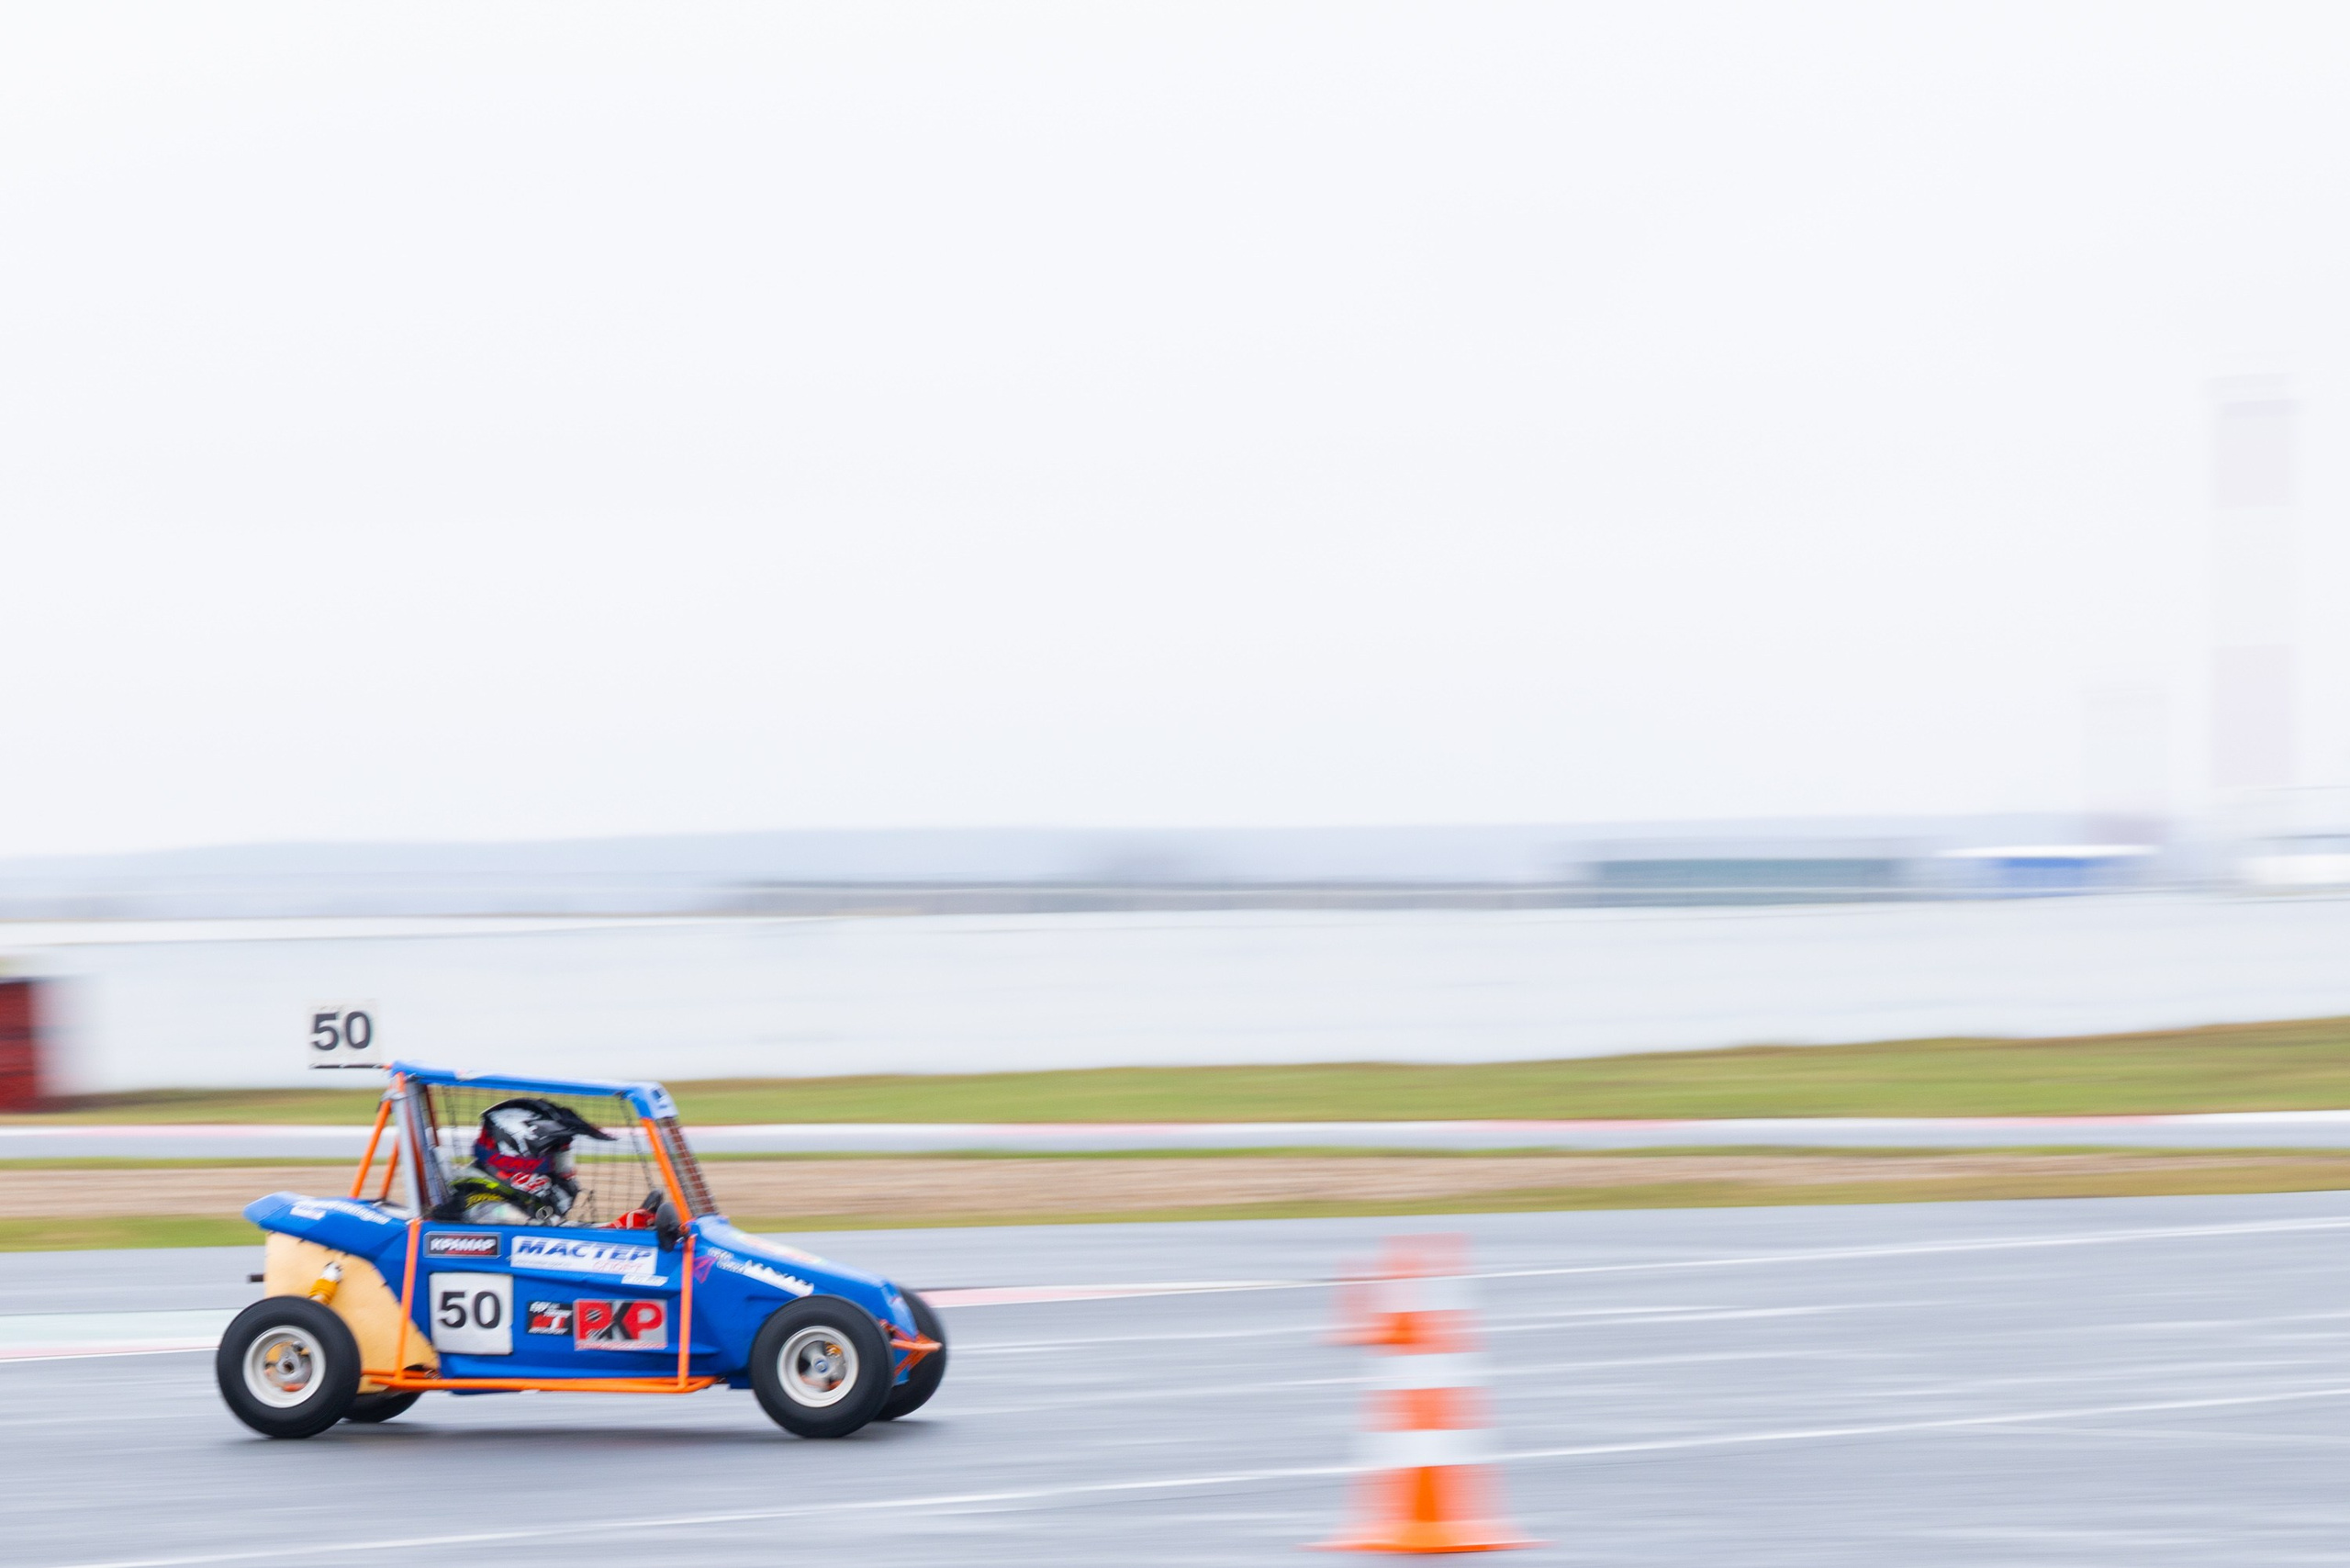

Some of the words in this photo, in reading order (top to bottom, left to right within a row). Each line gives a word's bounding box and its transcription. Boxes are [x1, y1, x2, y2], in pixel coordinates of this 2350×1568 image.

[311, 1011, 372, 1051] 50
[517, 1238, 655, 1261] МАСТЕР
[439, 1290, 502, 1329] 50
